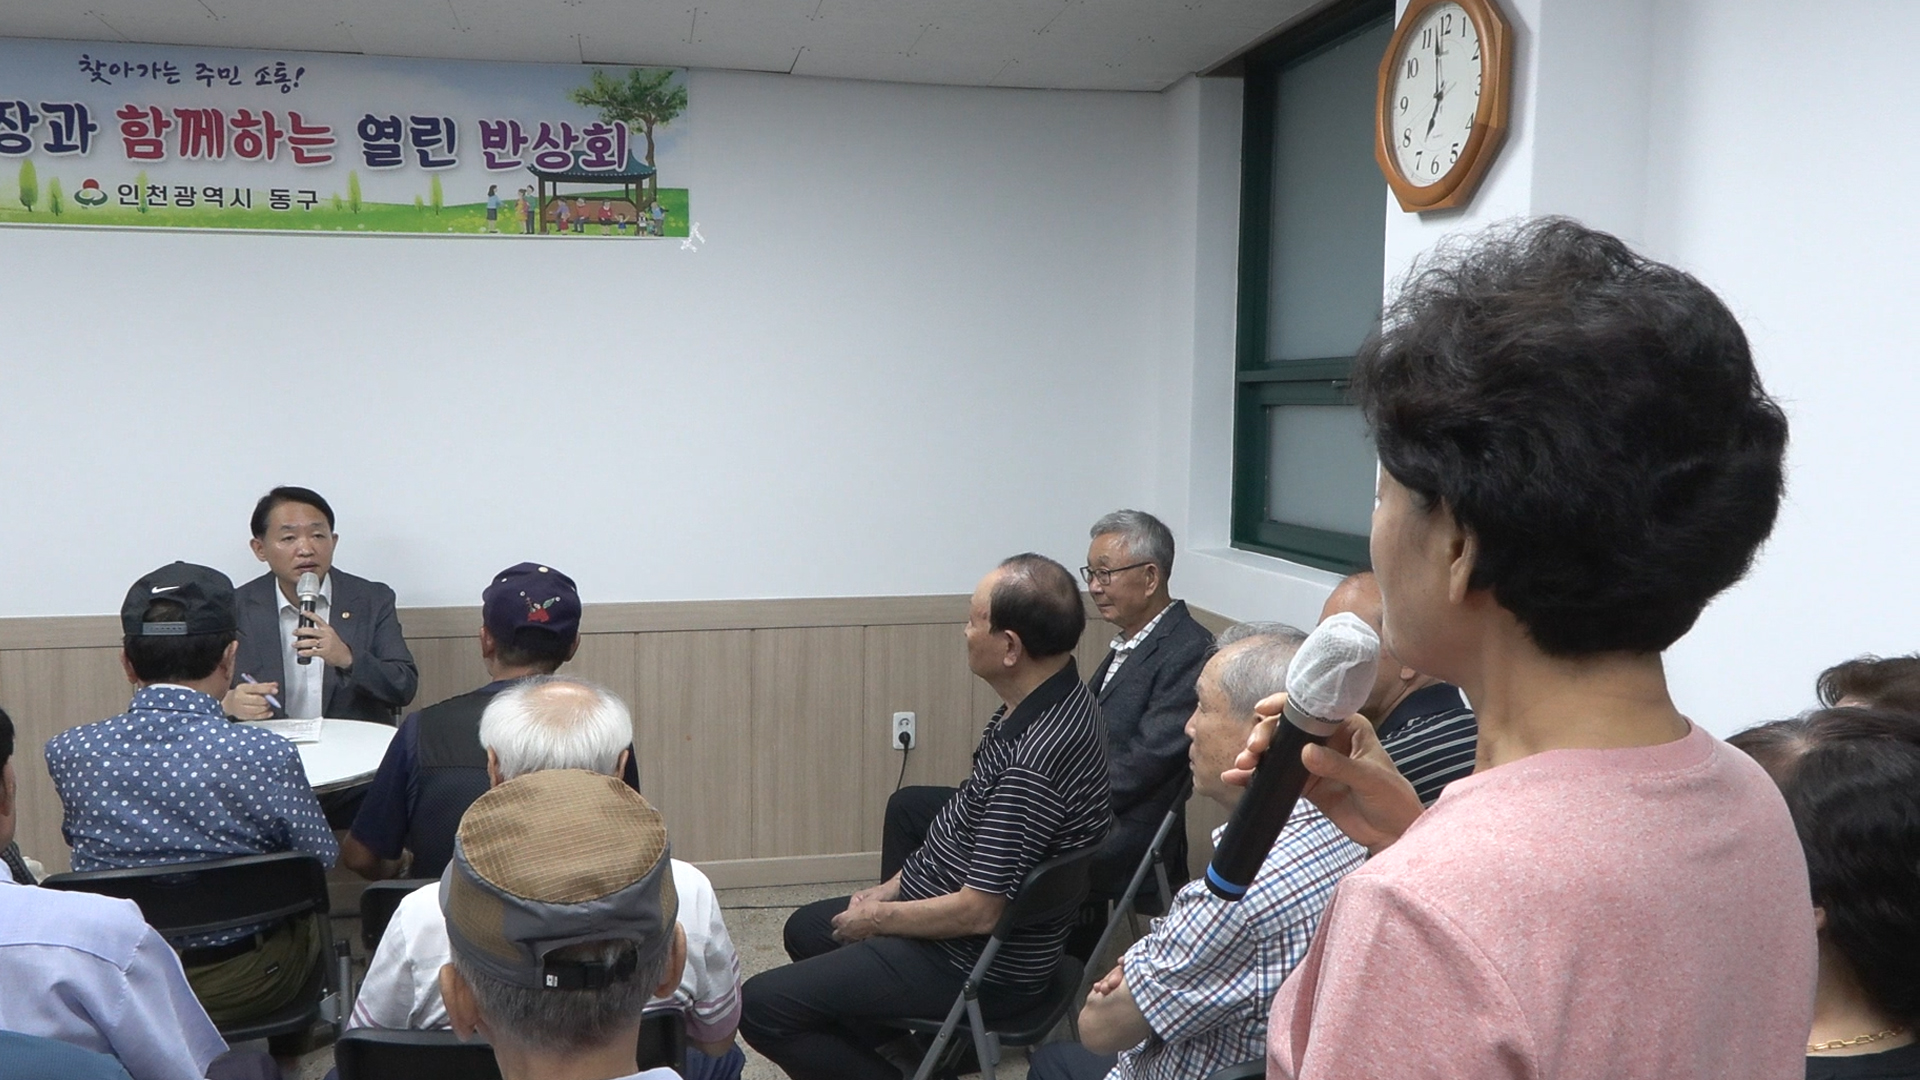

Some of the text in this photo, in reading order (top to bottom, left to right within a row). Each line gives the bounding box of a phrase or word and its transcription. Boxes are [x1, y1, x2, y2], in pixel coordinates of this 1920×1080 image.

[1440, 14, 1452, 36] 12
[1461, 16, 1467, 38] 1
[1422, 28, 1432, 49] 11
[78, 54, 305, 94] 찾아가는 주민 소통!
[1406, 57, 1419, 79] 10
[1400, 96, 1408, 115] 9
[1465, 112, 1475, 131] 4
[116, 104, 336, 165] 함께하는
[357, 113, 457, 169] 열린
[478, 119, 631, 170] 반상회
[1402, 128, 1412, 148] 8
[1415, 151, 1423, 171] 7
[1431, 155, 1440, 175] 6
[1449, 143, 1459, 165] 5
[117, 184, 319, 211] 인천광역시 동구
